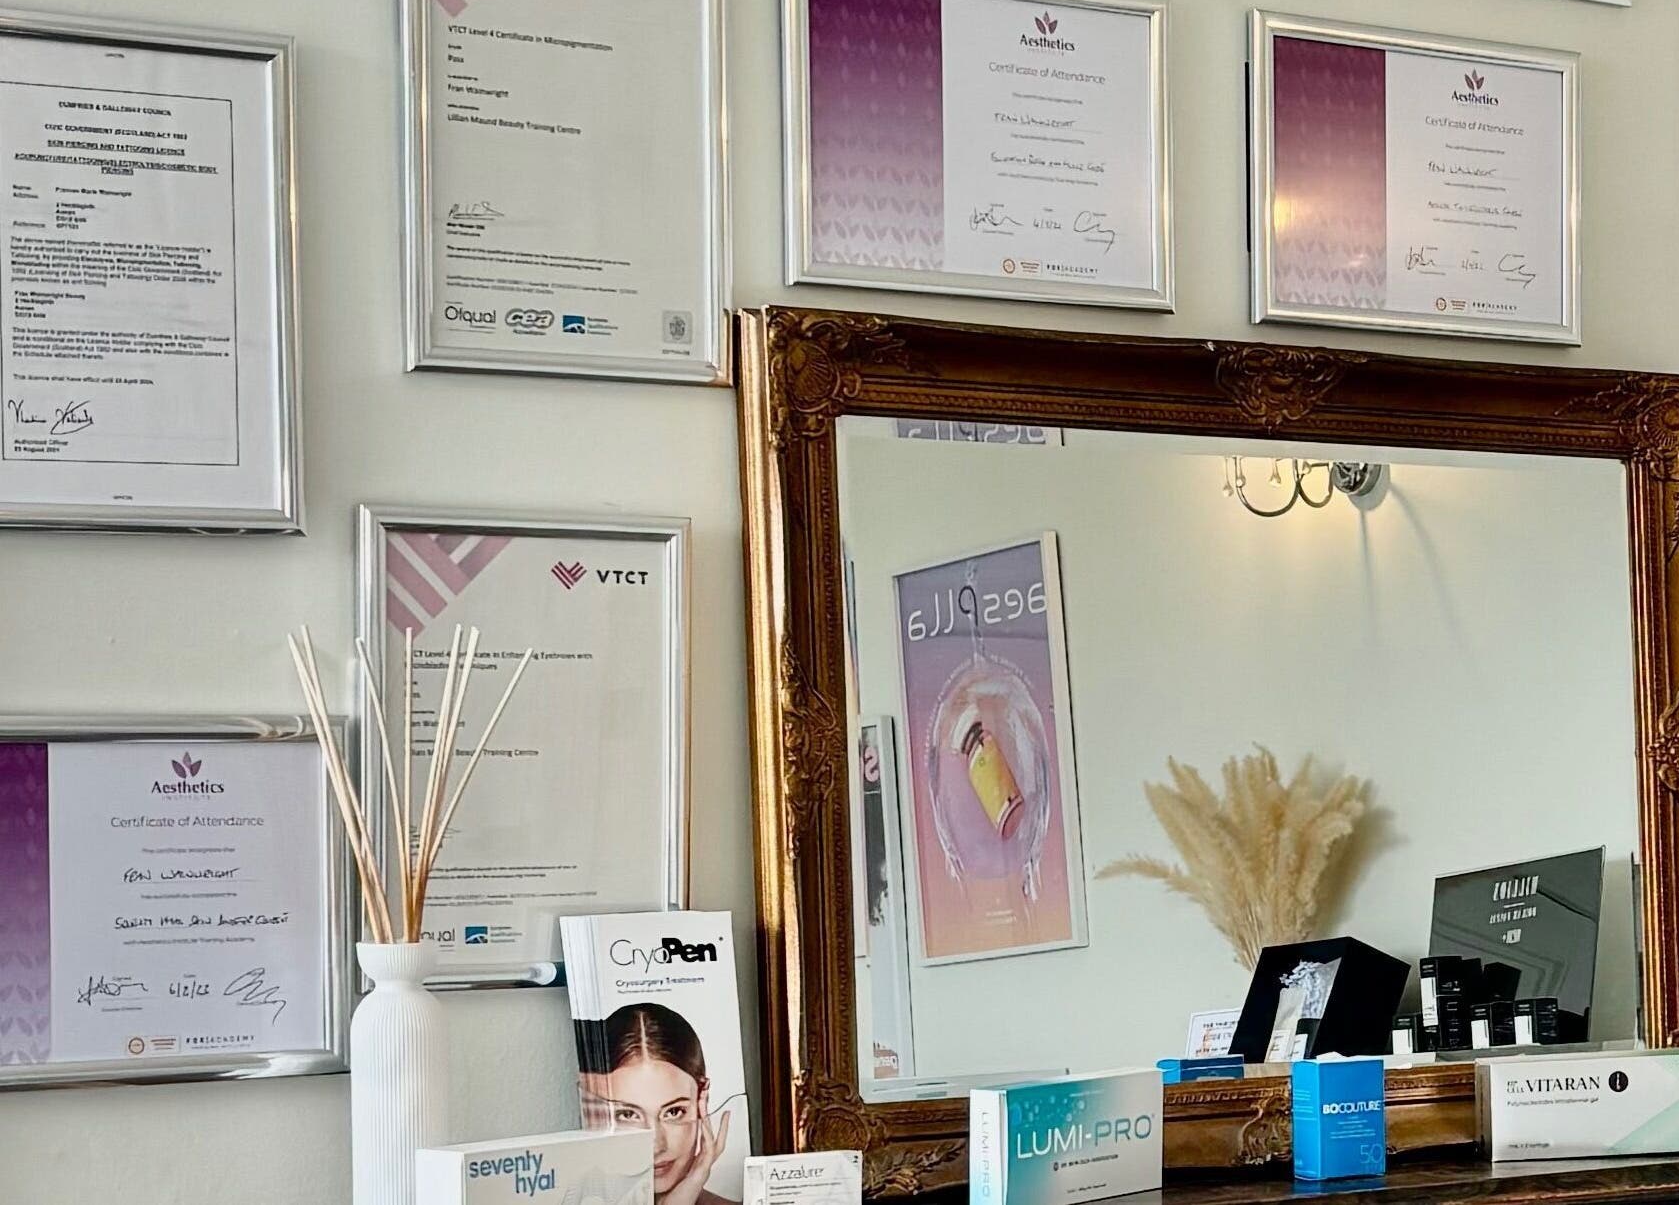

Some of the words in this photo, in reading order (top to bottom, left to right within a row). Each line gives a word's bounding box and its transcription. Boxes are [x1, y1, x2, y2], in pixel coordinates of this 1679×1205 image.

[469, 28, 487, 36] Level
[496, 31, 533, 42] Certificate
[1019, 34, 1075, 51] Aesthetics
[989, 62, 1039, 77] Certificate
[1050, 70, 1106, 84] Attendance
[1452, 91, 1499, 106] Aesthetics
[1425, 116, 1467, 130] Certificate
[1477, 122, 1525, 136] Attendance
[597, 570, 648, 584] VTCT
[151, 780, 224, 793] Aesthetics
[111, 817, 175, 827] Certificate
[192, 816, 264, 827] Attendance
[610, 938, 717, 973] CryoPen
[1526, 1076, 1600, 1093] VITARAN
[1323, 1099, 1380, 1115] BOCOUTURE
[1017, 1115, 1152, 1159] LUMI-PRO
[1360, 1144, 1382, 1164] 50
[469, 1151, 543, 1179] seventy
[515, 1169, 555, 1196] hyal
